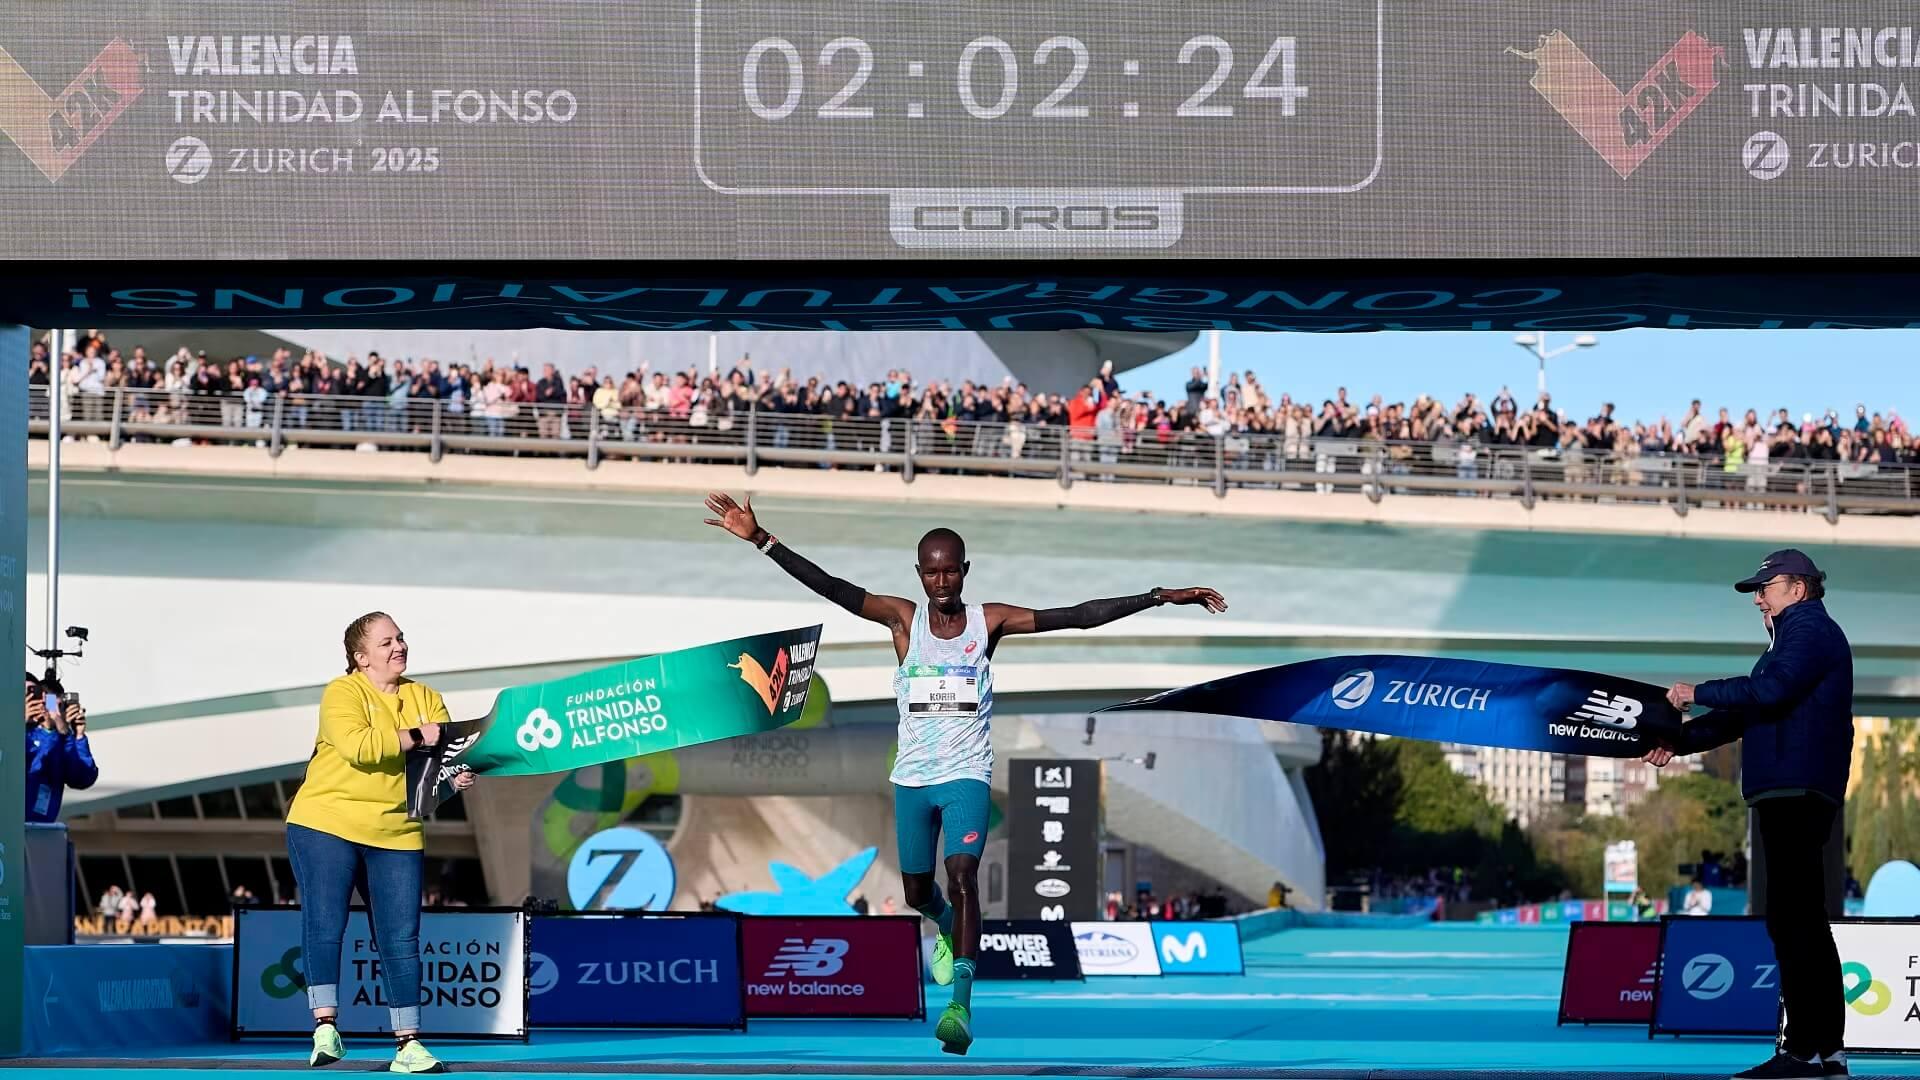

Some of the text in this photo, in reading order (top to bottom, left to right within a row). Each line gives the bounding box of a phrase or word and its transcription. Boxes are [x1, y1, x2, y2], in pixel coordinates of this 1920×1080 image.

[167, 35, 358, 75] VALENCIA
[48, 73, 120, 155] 42K
[168, 89, 578, 123] TRINIDAD ALFONSO
[1617, 64, 1698, 149] 42K
[227, 147, 353, 174] ZURICH
[370, 146, 440, 173] 2025
[1806, 142, 1920, 168] ZURIC
[913, 205, 1159, 230] COROS
[566, 678, 657, 707] FUNDACIÓN
[929, 692, 956, 701] KORIR
[939, 679, 946, 690] 2
[1382, 680, 1492, 711] ZURICH
[565, 694, 662, 729] TRINIDAD
[571, 714, 668, 749] ALFONSO
[1548, 723, 1640, 741] new balance
[354, 939, 500, 955] FUACIÓN
[980, 934, 1050, 951] POWER
[352, 959, 501, 983] TRIDAD
[577, 959, 719, 985] ZURICH
[352, 985, 501, 1008] ALONSO
[747, 980, 865, 996] new balance
